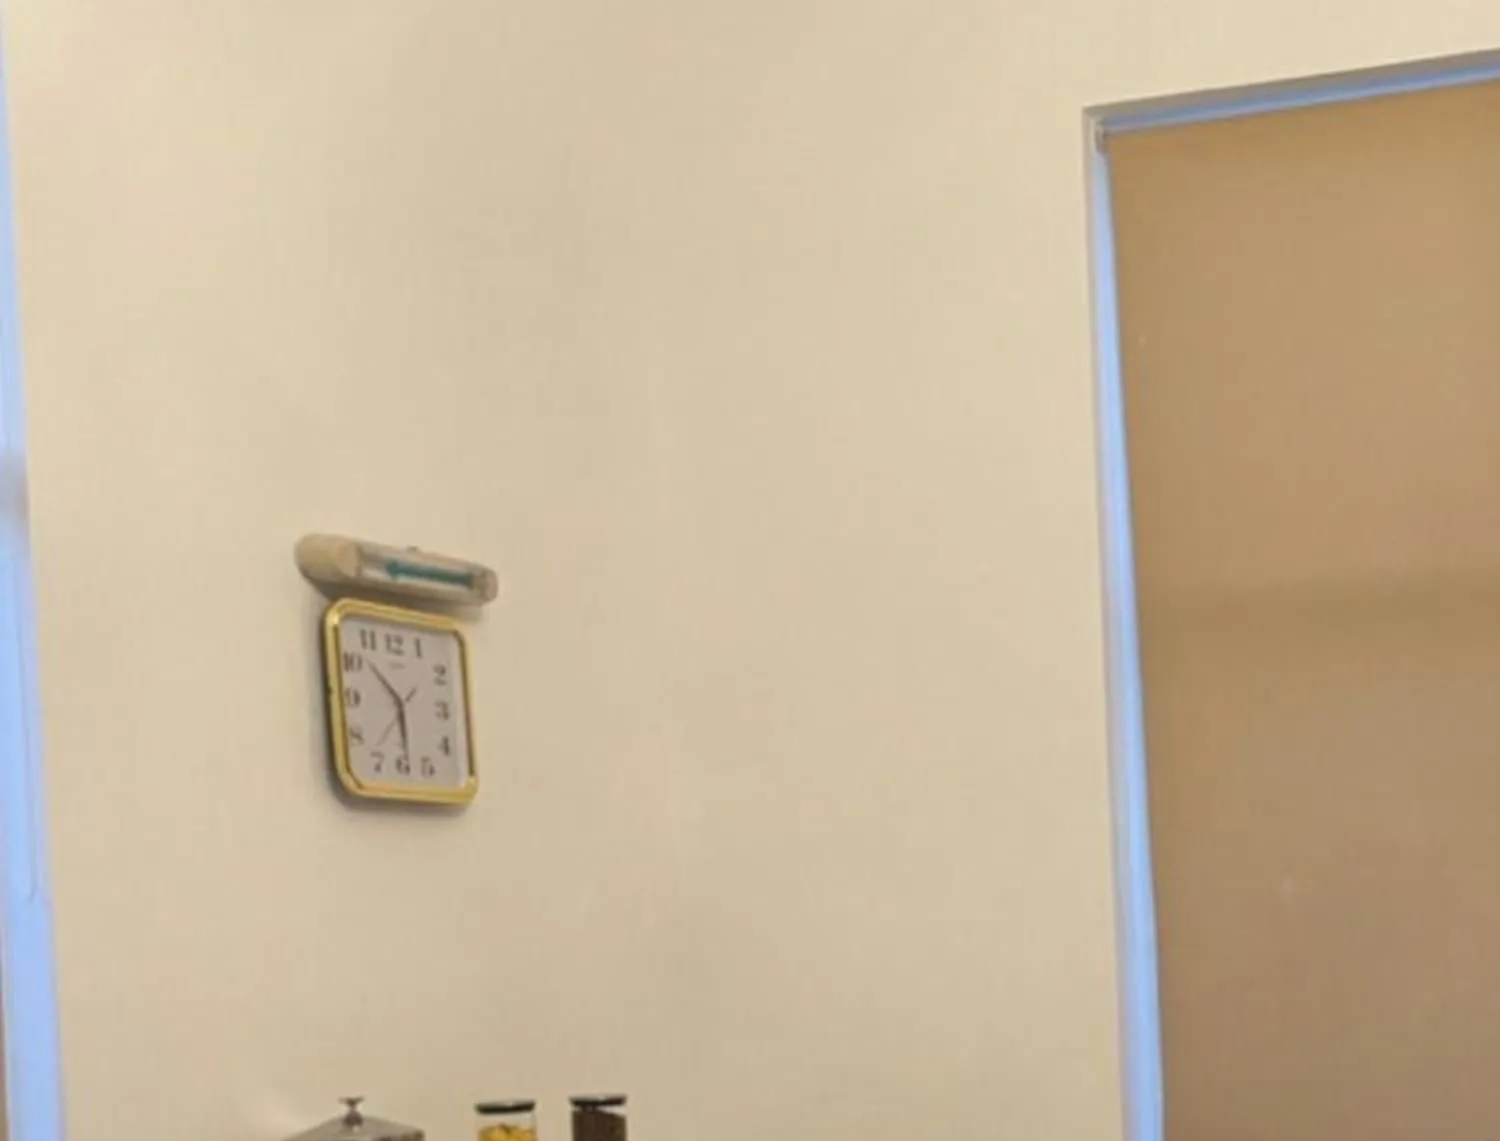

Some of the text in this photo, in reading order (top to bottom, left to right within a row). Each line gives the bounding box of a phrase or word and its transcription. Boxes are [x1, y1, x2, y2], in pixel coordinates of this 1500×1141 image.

[361, 629, 377, 651] 11
[384, 634, 404, 655] 12
[414, 639, 423, 659] 1
[344, 652, 362, 671] 10
[433, 665, 448, 685] 2
[346, 687, 361, 708] 9
[435, 702, 449, 720] 3
[350, 727, 365, 747] 8
[438, 737, 450, 756] 4
[370, 752, 385, 773] 7
[394, 757, 411, 775] 6
[420, 757, 436, 777] 5
